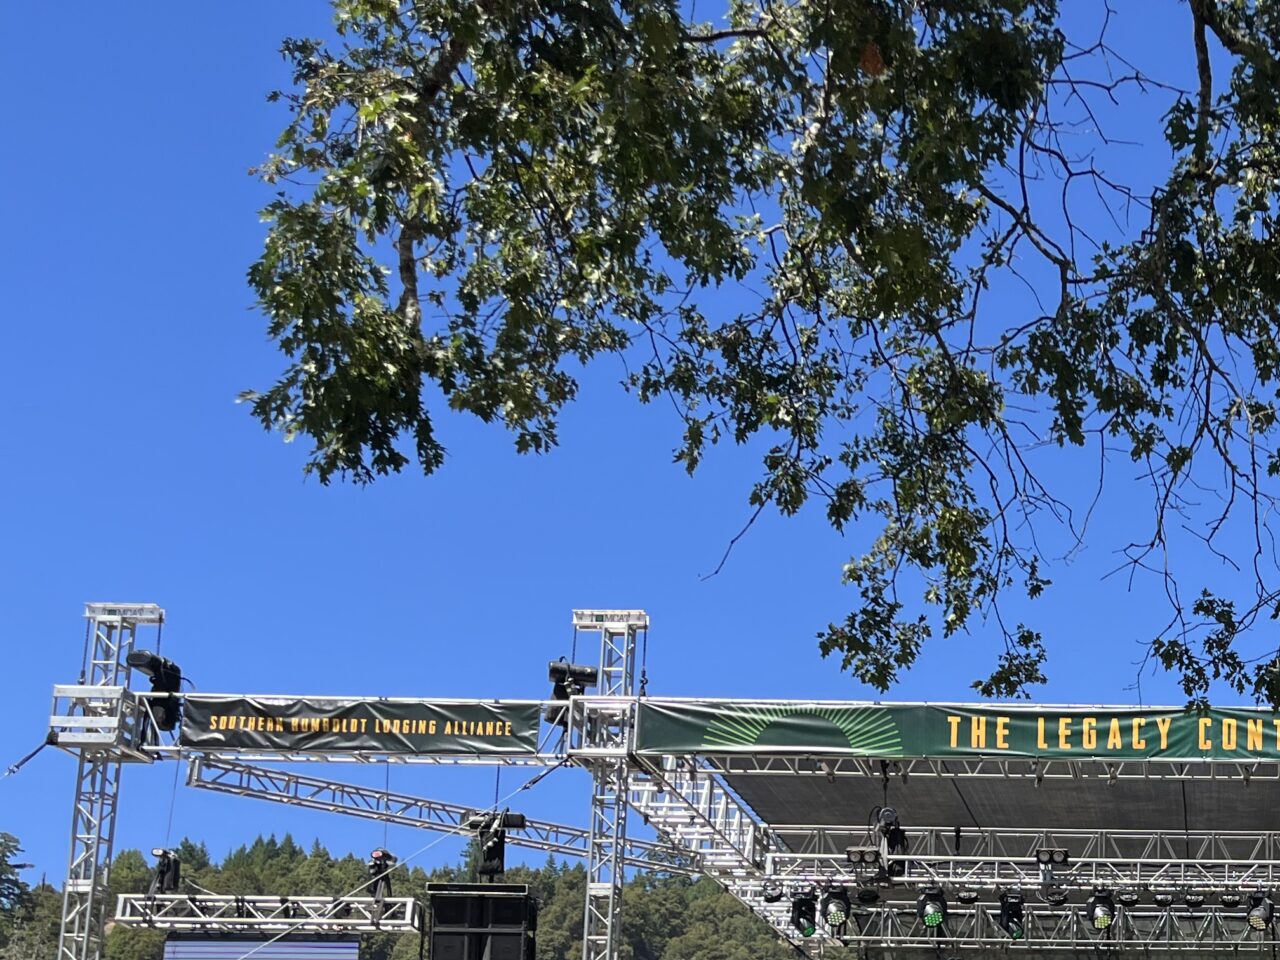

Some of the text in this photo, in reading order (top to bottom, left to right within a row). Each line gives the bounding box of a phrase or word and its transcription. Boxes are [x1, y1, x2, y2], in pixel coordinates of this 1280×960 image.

[209, 715, 512, 736] SOUTHERN HUMBOLDT LODGING ALLIANCE
[947, 715, 1010, 749] THE
[1037, 716, 1170, 750] LEGACY
